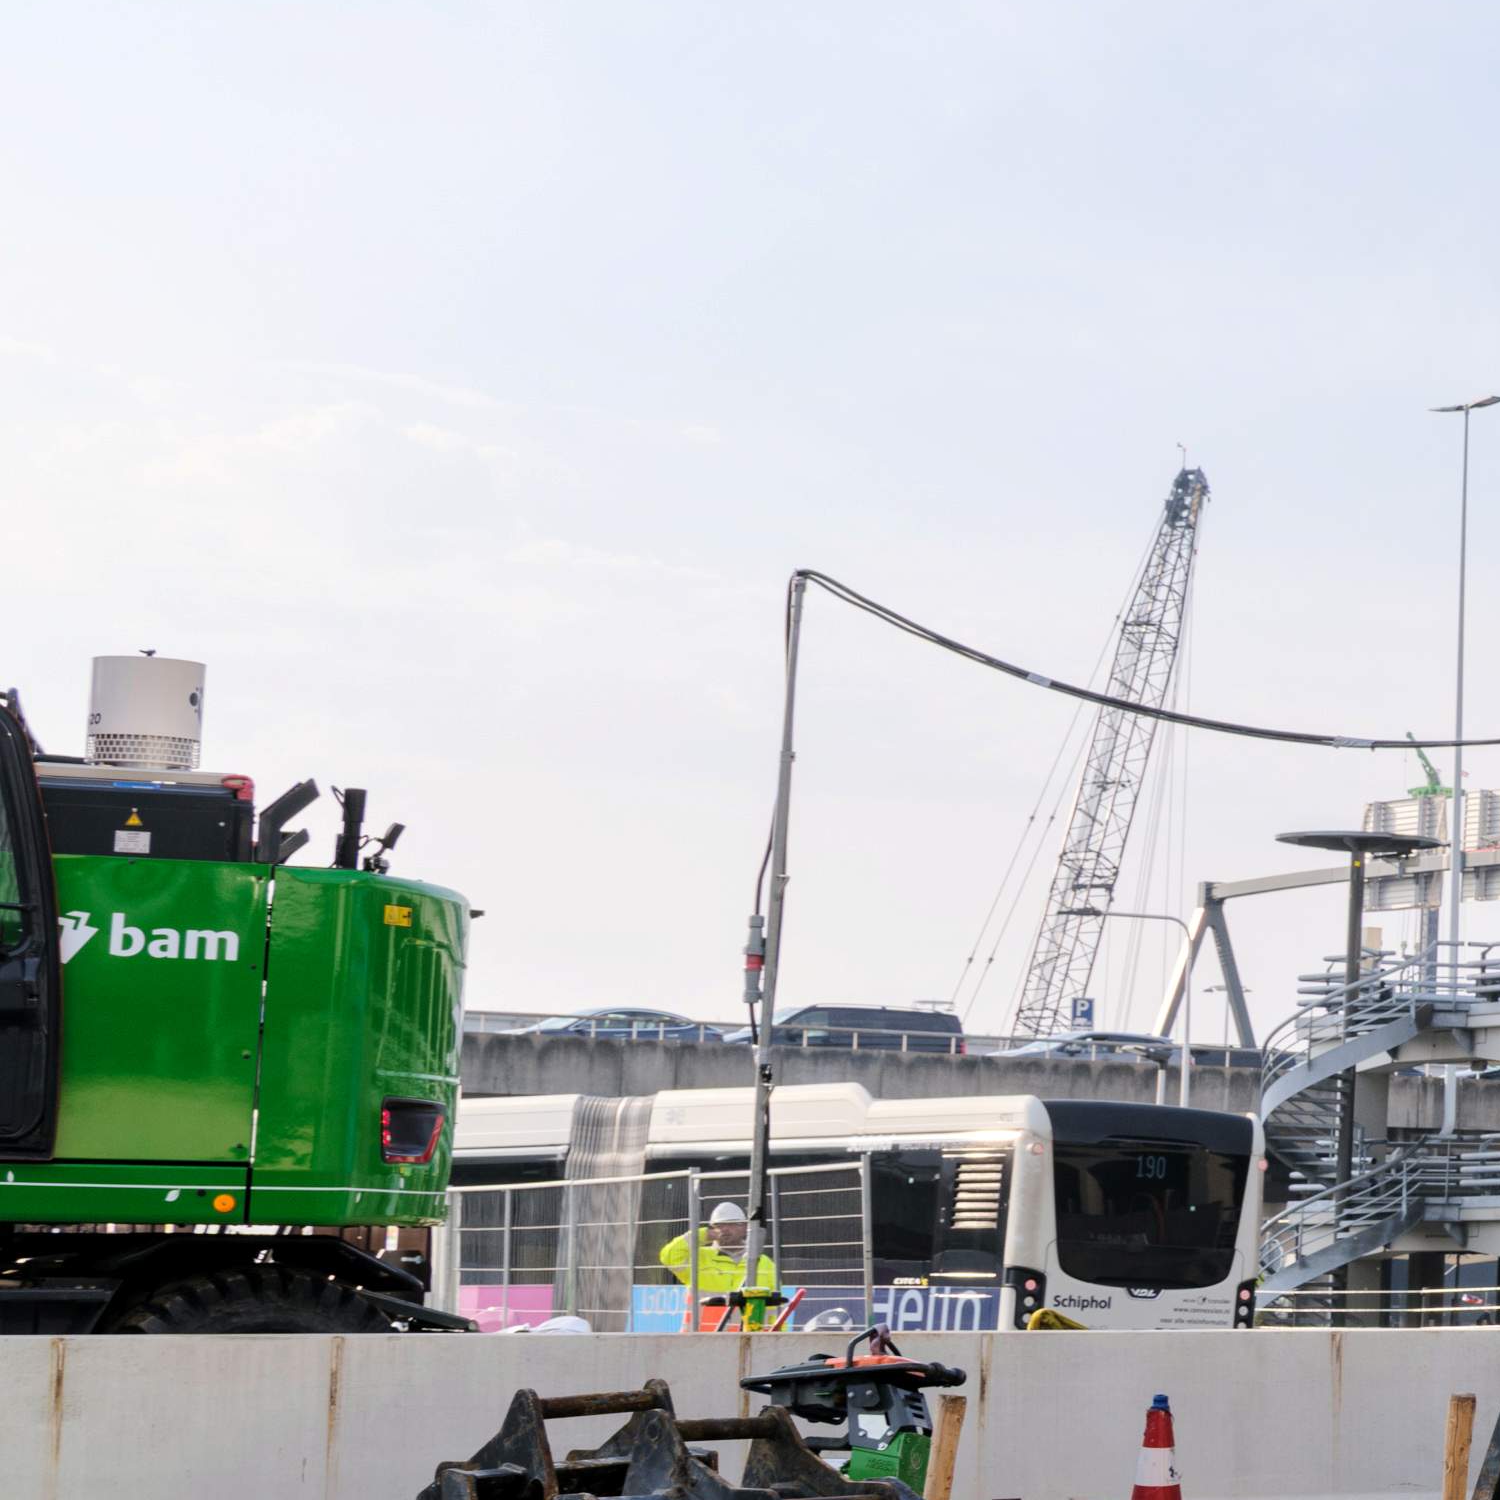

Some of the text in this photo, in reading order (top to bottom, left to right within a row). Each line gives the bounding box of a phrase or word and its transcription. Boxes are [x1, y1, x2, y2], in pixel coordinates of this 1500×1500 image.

[109, 912, 240, 961] bam
[1076, 1000, 1089, 1016] P
[1136, 1156, 1167, 1179] 190
[1053, 1295, 1111, 1310] Schiphol
